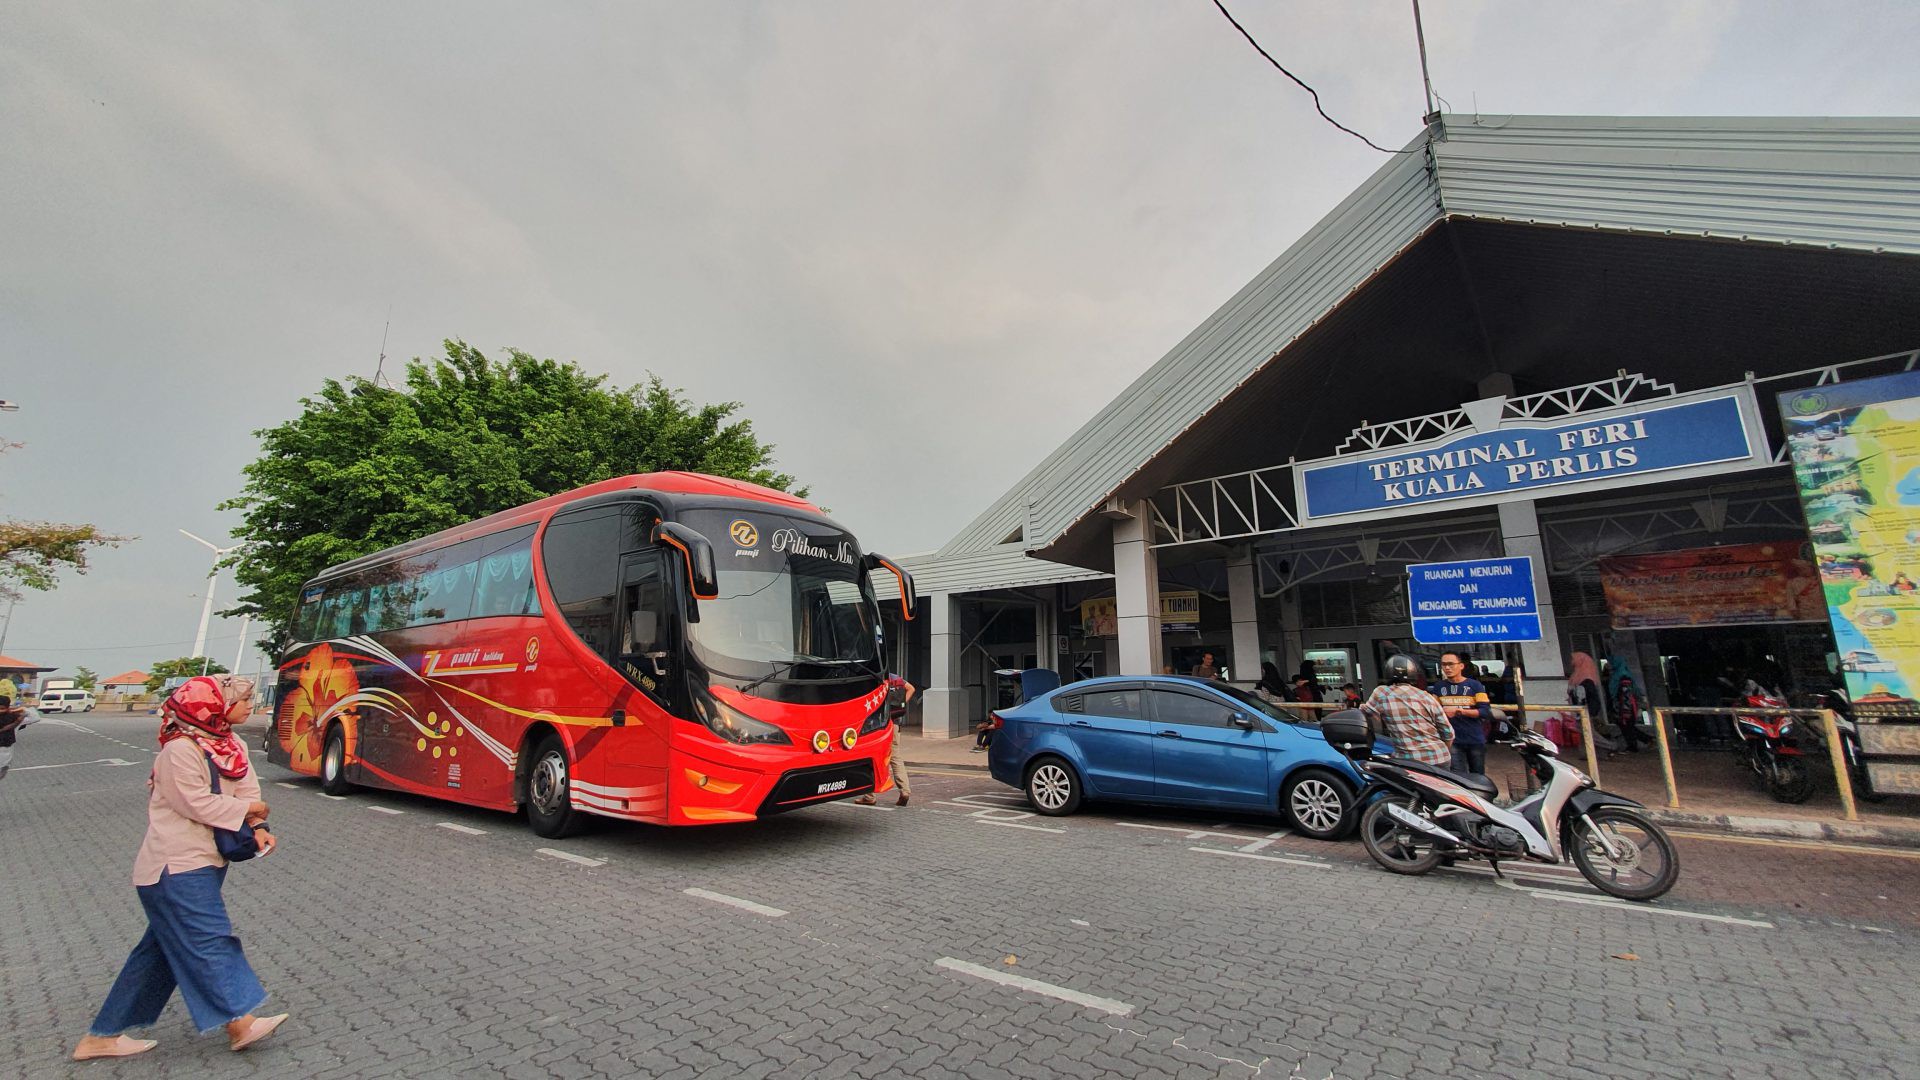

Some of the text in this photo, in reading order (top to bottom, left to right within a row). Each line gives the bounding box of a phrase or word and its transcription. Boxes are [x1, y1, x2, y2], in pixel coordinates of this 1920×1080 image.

[1368, 418, 1649, 481] TERMINAL FERI
[1383, 446, 1638, 501] KUALA PERLIS
[735, 549, 760, 558] panji
[771, 528, 854, 565] Pilihan Mu
[1424, 565, 1512, 580] RUANGAN MENURUN
[1460, 583, 1478, 594] DAN
[1168, 598, 1198, 613] TUANKU
[1418, 596, 1527, 611] MENGAMBIL PENUMPANG
[1442, 624, 1508, 635] BAS SAHAJA
[451, 649, 480, 667] panji
